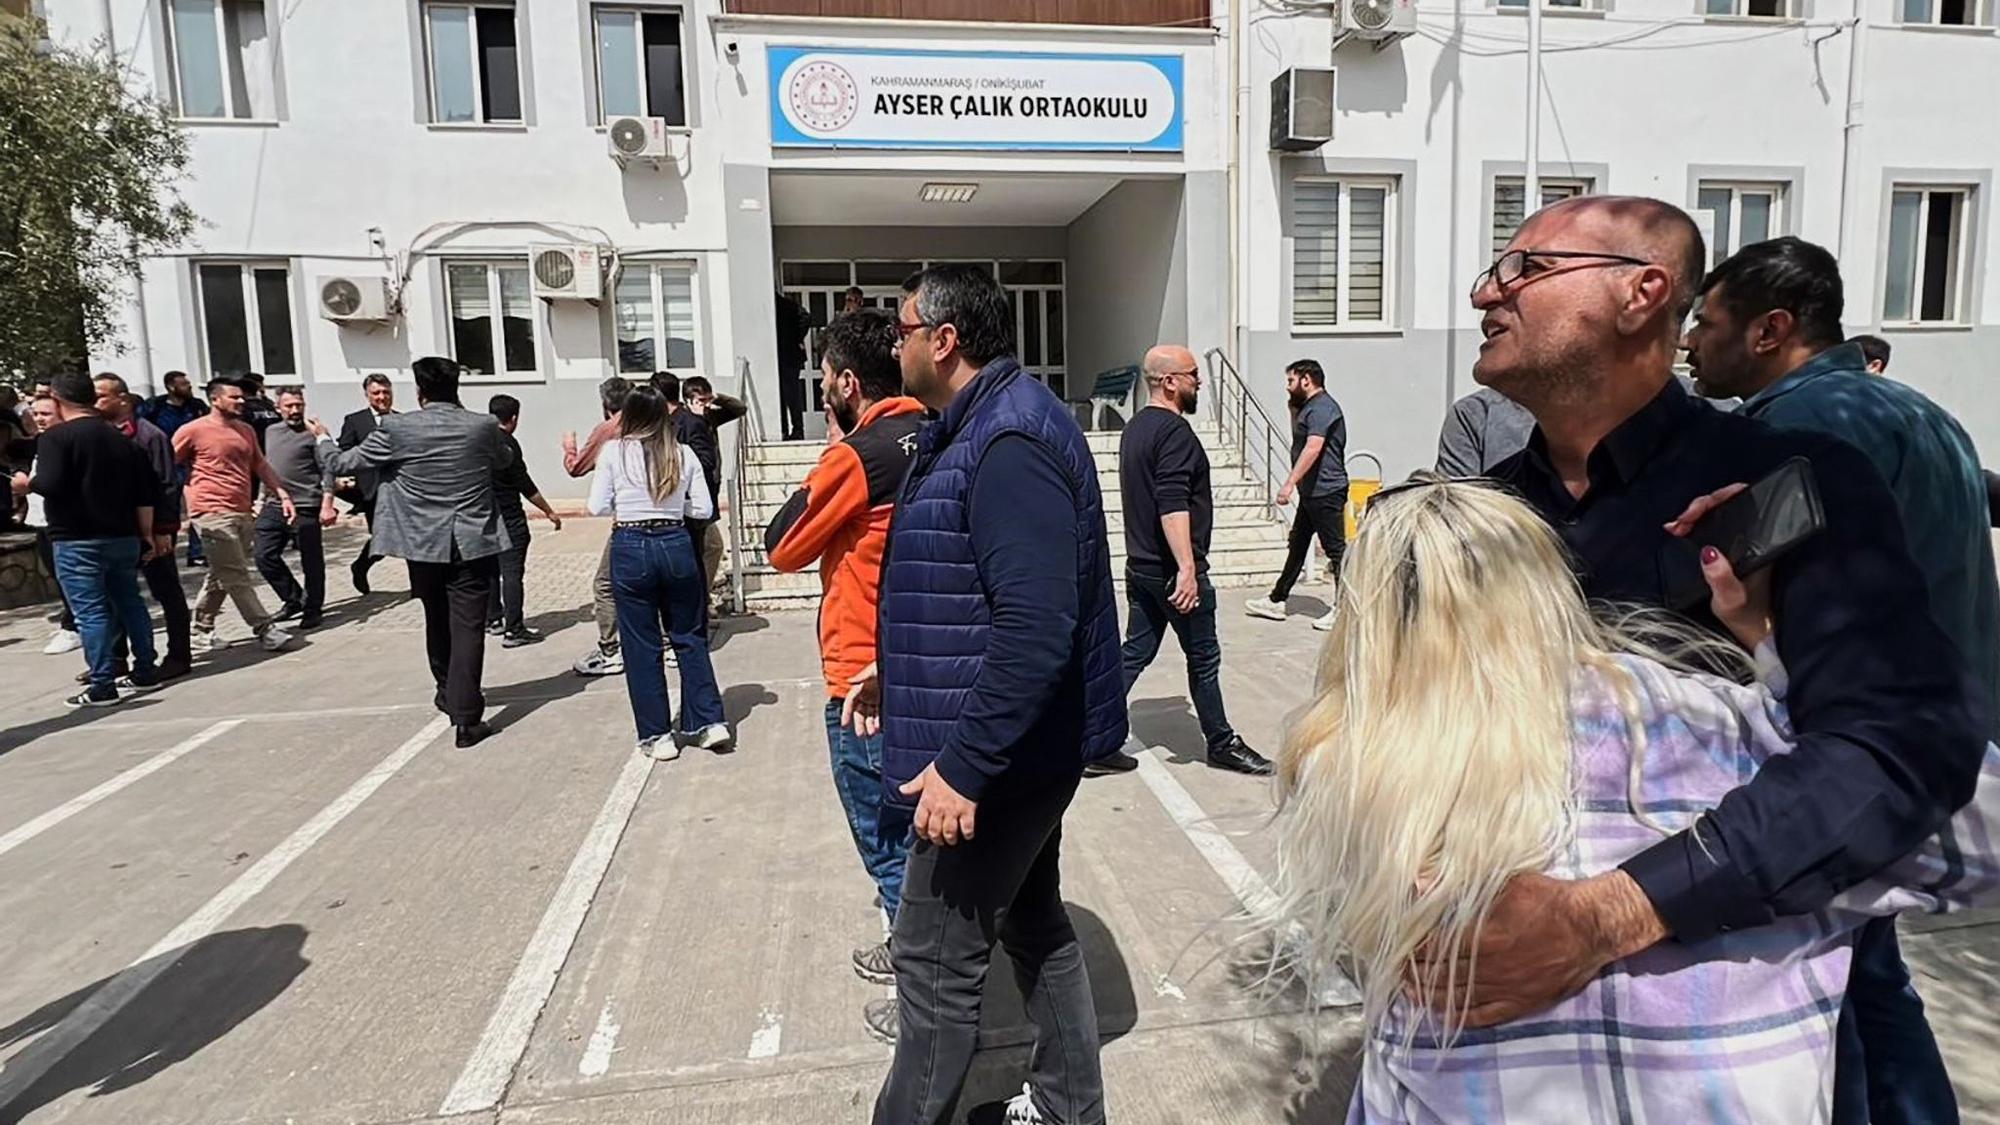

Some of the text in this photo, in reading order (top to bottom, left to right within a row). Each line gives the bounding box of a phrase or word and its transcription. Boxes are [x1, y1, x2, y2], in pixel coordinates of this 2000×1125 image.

[871, 76, 972, 90] KAHRAMANMARAŞ
[873, 93, 944, 116] AYSER
[949, 95, 1014, 120] ÇALIK
[1019, 95, 1148, 119] ORTAOKULU
